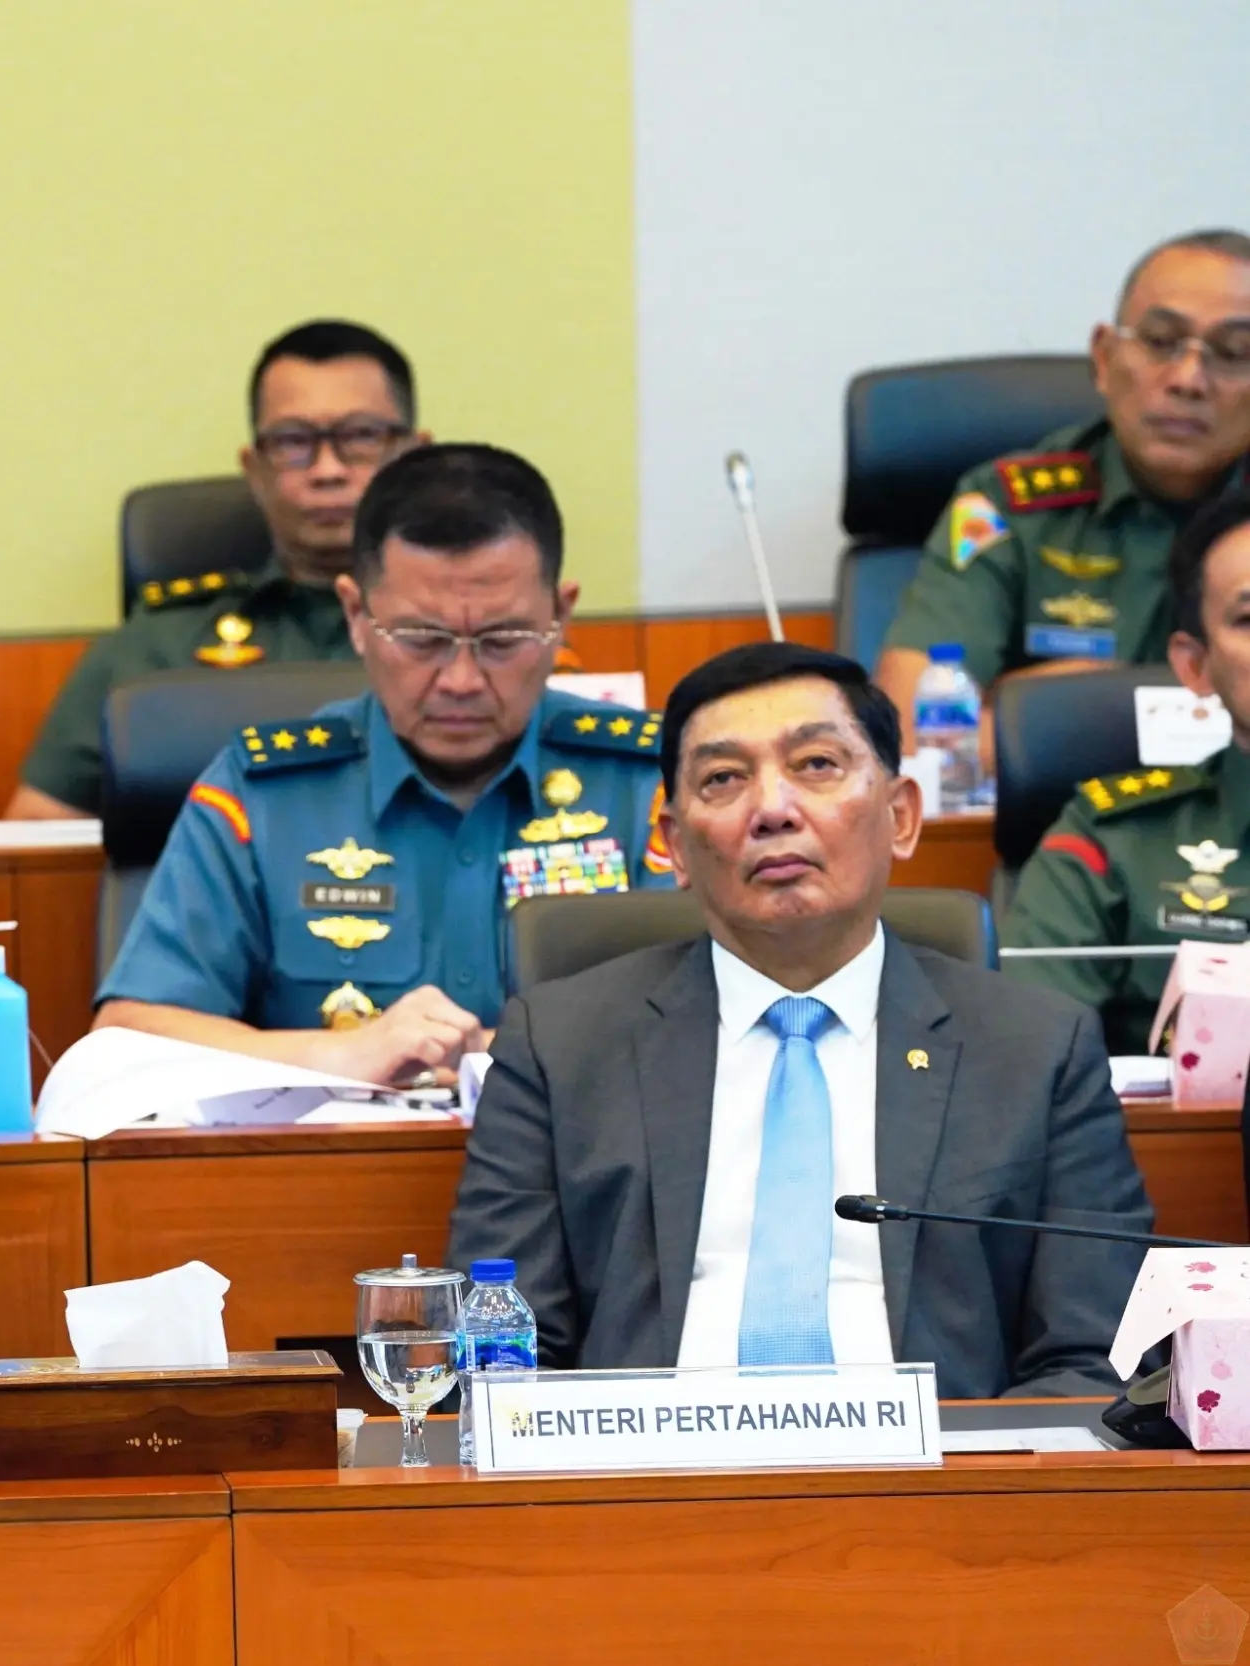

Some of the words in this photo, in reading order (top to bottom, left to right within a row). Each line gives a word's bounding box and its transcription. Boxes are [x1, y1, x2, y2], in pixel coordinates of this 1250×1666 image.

[314, 886, 382, 903] EDWIN
[511, 1407, 646, 1438] MENTERI
[656, 1401, 866, 1433] PERTAHANAN
[877, 1400, 906, 1427] RI
